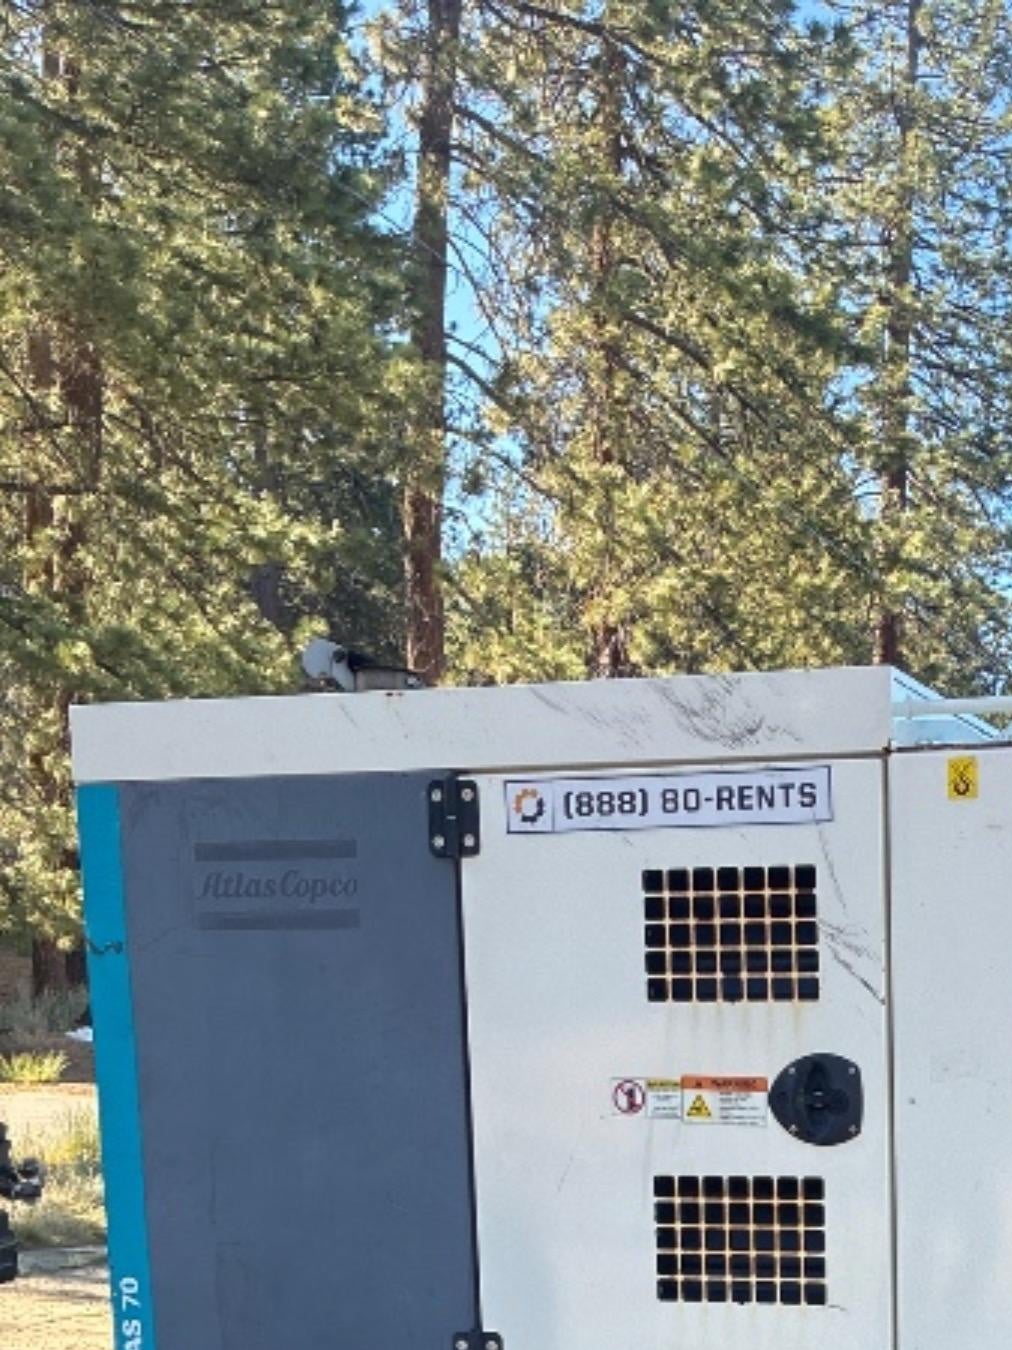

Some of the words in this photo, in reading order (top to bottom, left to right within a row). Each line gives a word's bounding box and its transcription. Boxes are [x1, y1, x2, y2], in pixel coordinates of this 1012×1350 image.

[563, 789, 649, 819] (888)
[661, 782, 817, 813] 80-RENTS
[119, 1277, 141, 1312] 70
